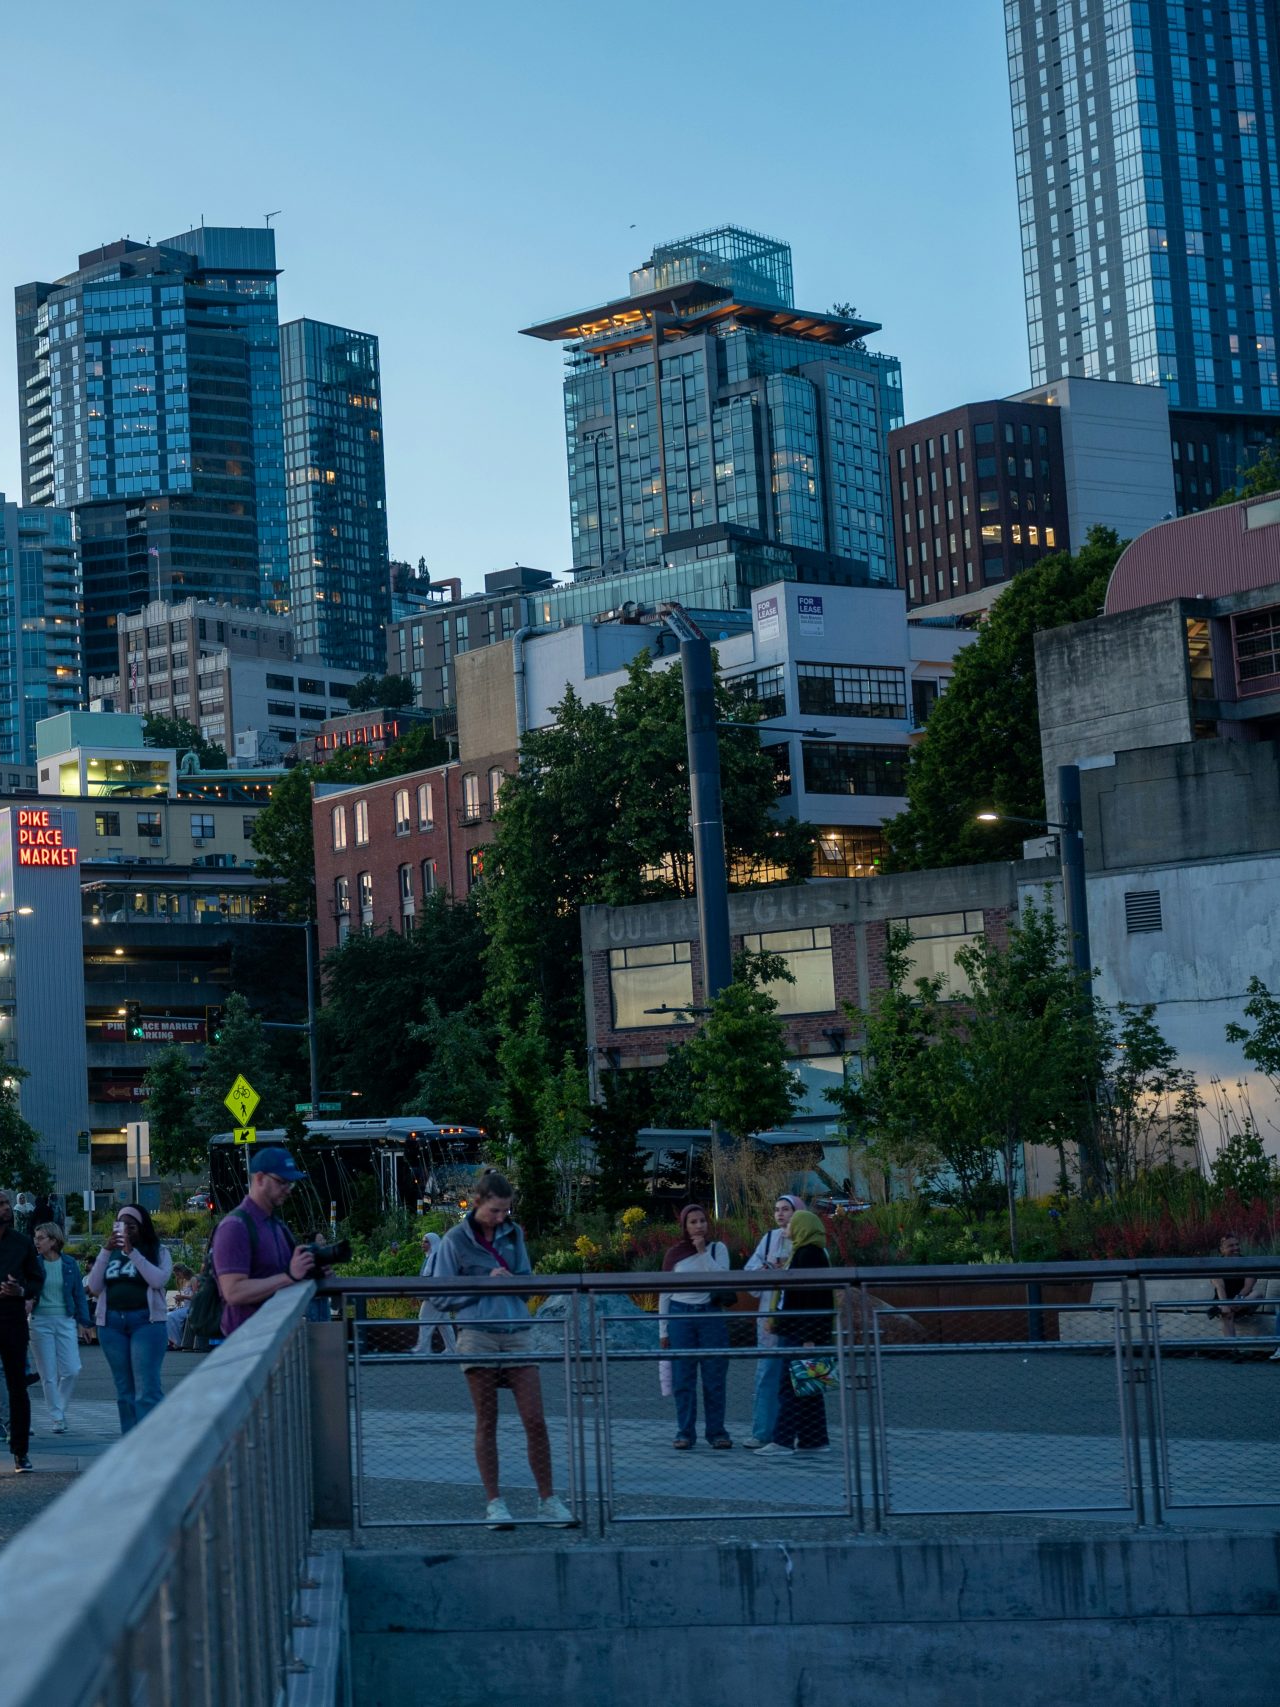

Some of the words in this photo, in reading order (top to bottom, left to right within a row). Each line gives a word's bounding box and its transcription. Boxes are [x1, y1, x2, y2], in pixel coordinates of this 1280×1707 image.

[758, 601, 770, 611] FOR
[799, 597, 814, 605] FOR
[758, 607, 777, 619] LEASE
[799, 605, 822, 614] LEASE
[19, 811, 49, 827] PIKE
[19, 829, 62, 845] PLACE
[20, 848, 78, 866] MARKET
[161, 1022, 199, 1031] MARKET
[140, 1031, 174, 1040] ARKING
[105, 1259, 137, 1279] 24
